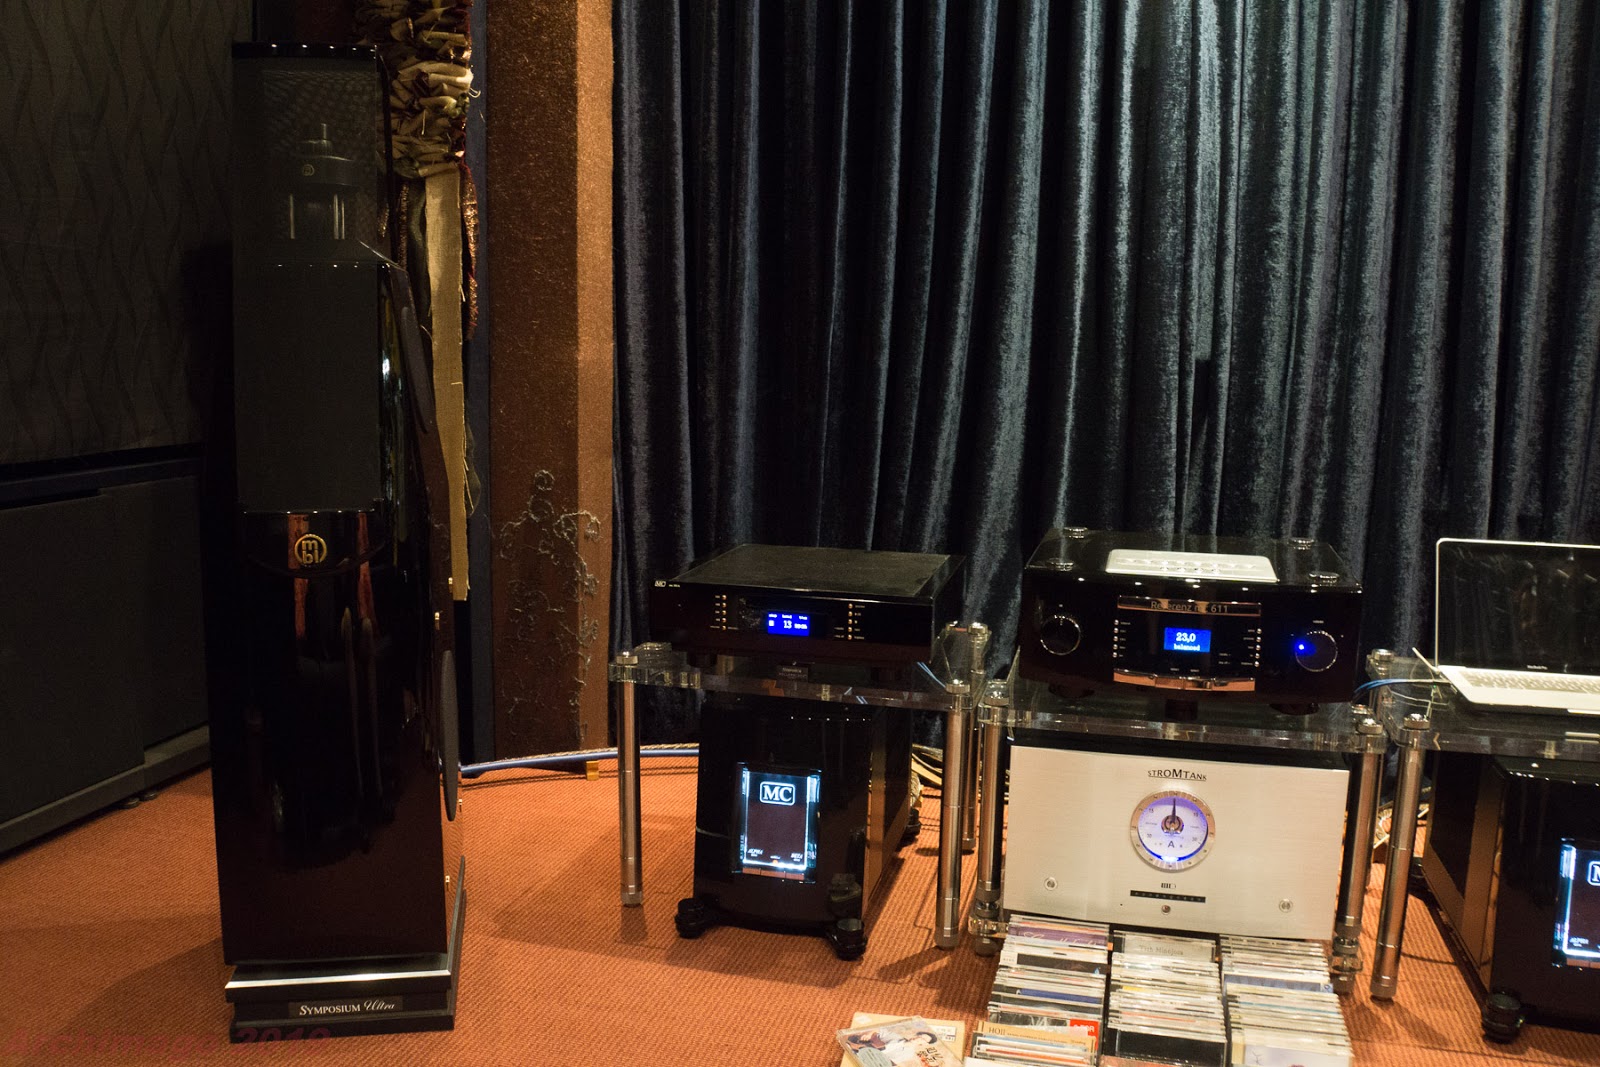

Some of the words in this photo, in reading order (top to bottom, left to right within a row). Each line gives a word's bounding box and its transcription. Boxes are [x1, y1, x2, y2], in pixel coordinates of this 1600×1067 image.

[1211, 605, 1228, 613] 611
[1173, 643, 1201, 652] balanced
[763, 785, 792, 802] MC
[299, 1004, 361, 1016] SYMPOSIUM
[363, 999, 395, 1011] Ultra
